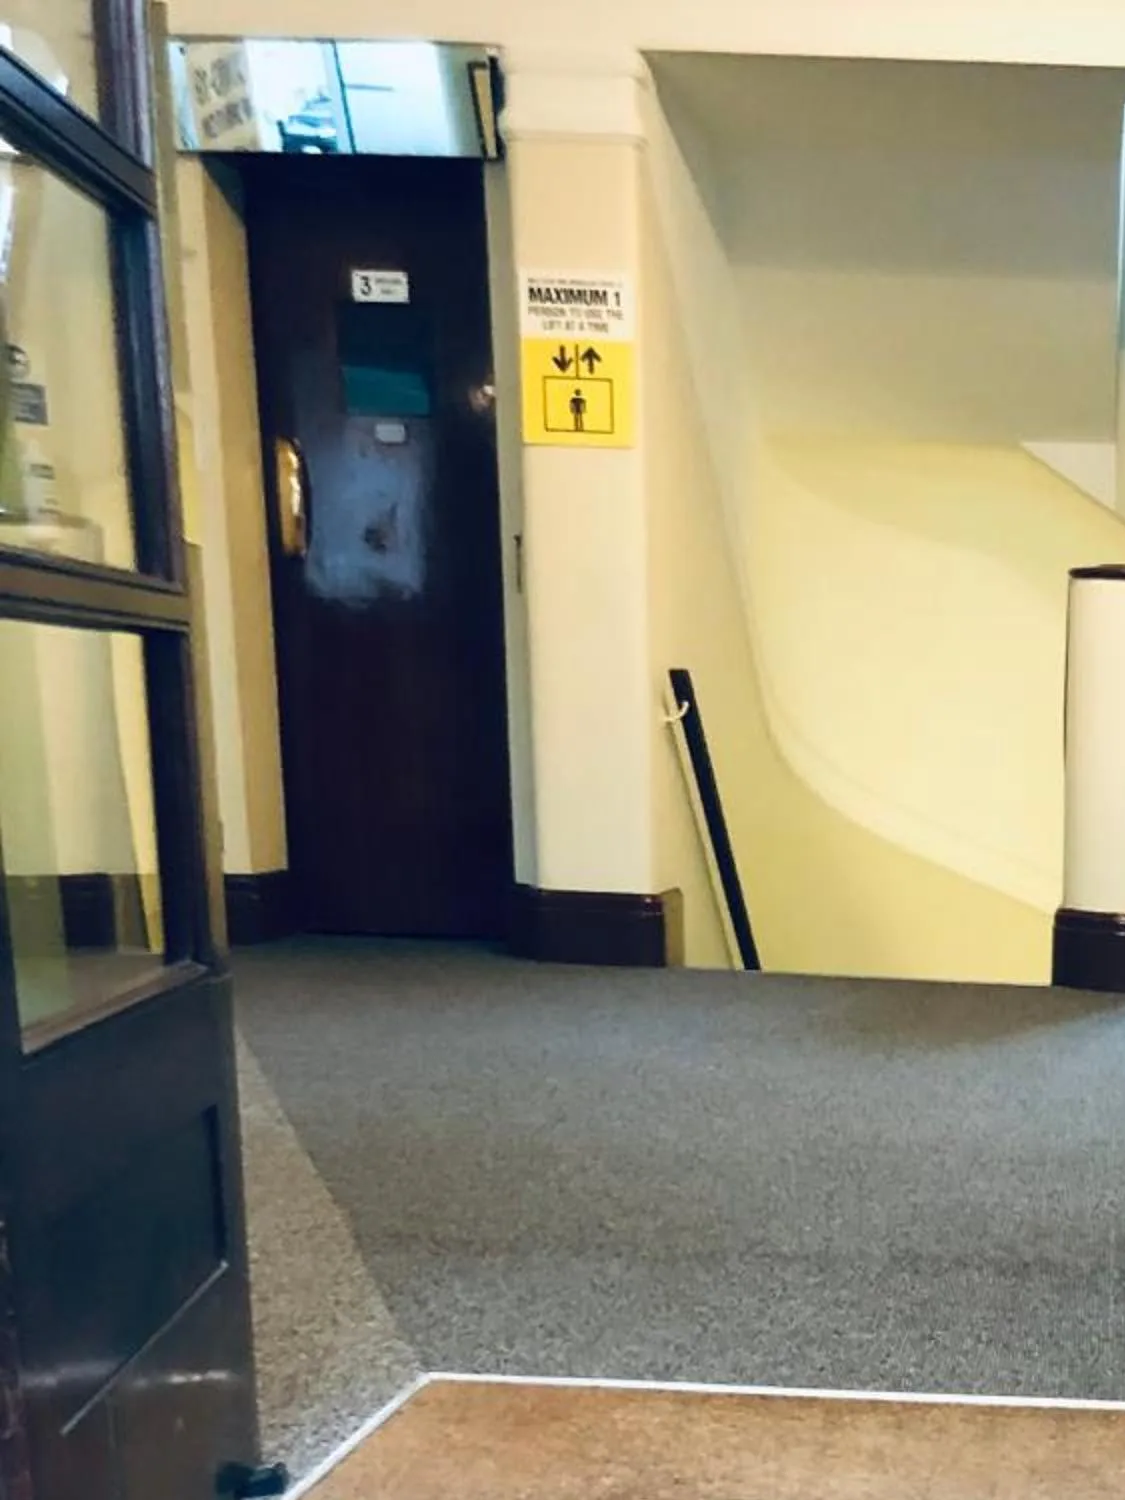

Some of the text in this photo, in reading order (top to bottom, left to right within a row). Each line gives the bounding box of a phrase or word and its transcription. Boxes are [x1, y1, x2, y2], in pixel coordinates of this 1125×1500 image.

[360, 276, 372, 296] 3
[527, 287, 621, 307] MAXIMUM 1
[527, 306, 566, 318] PERSON
